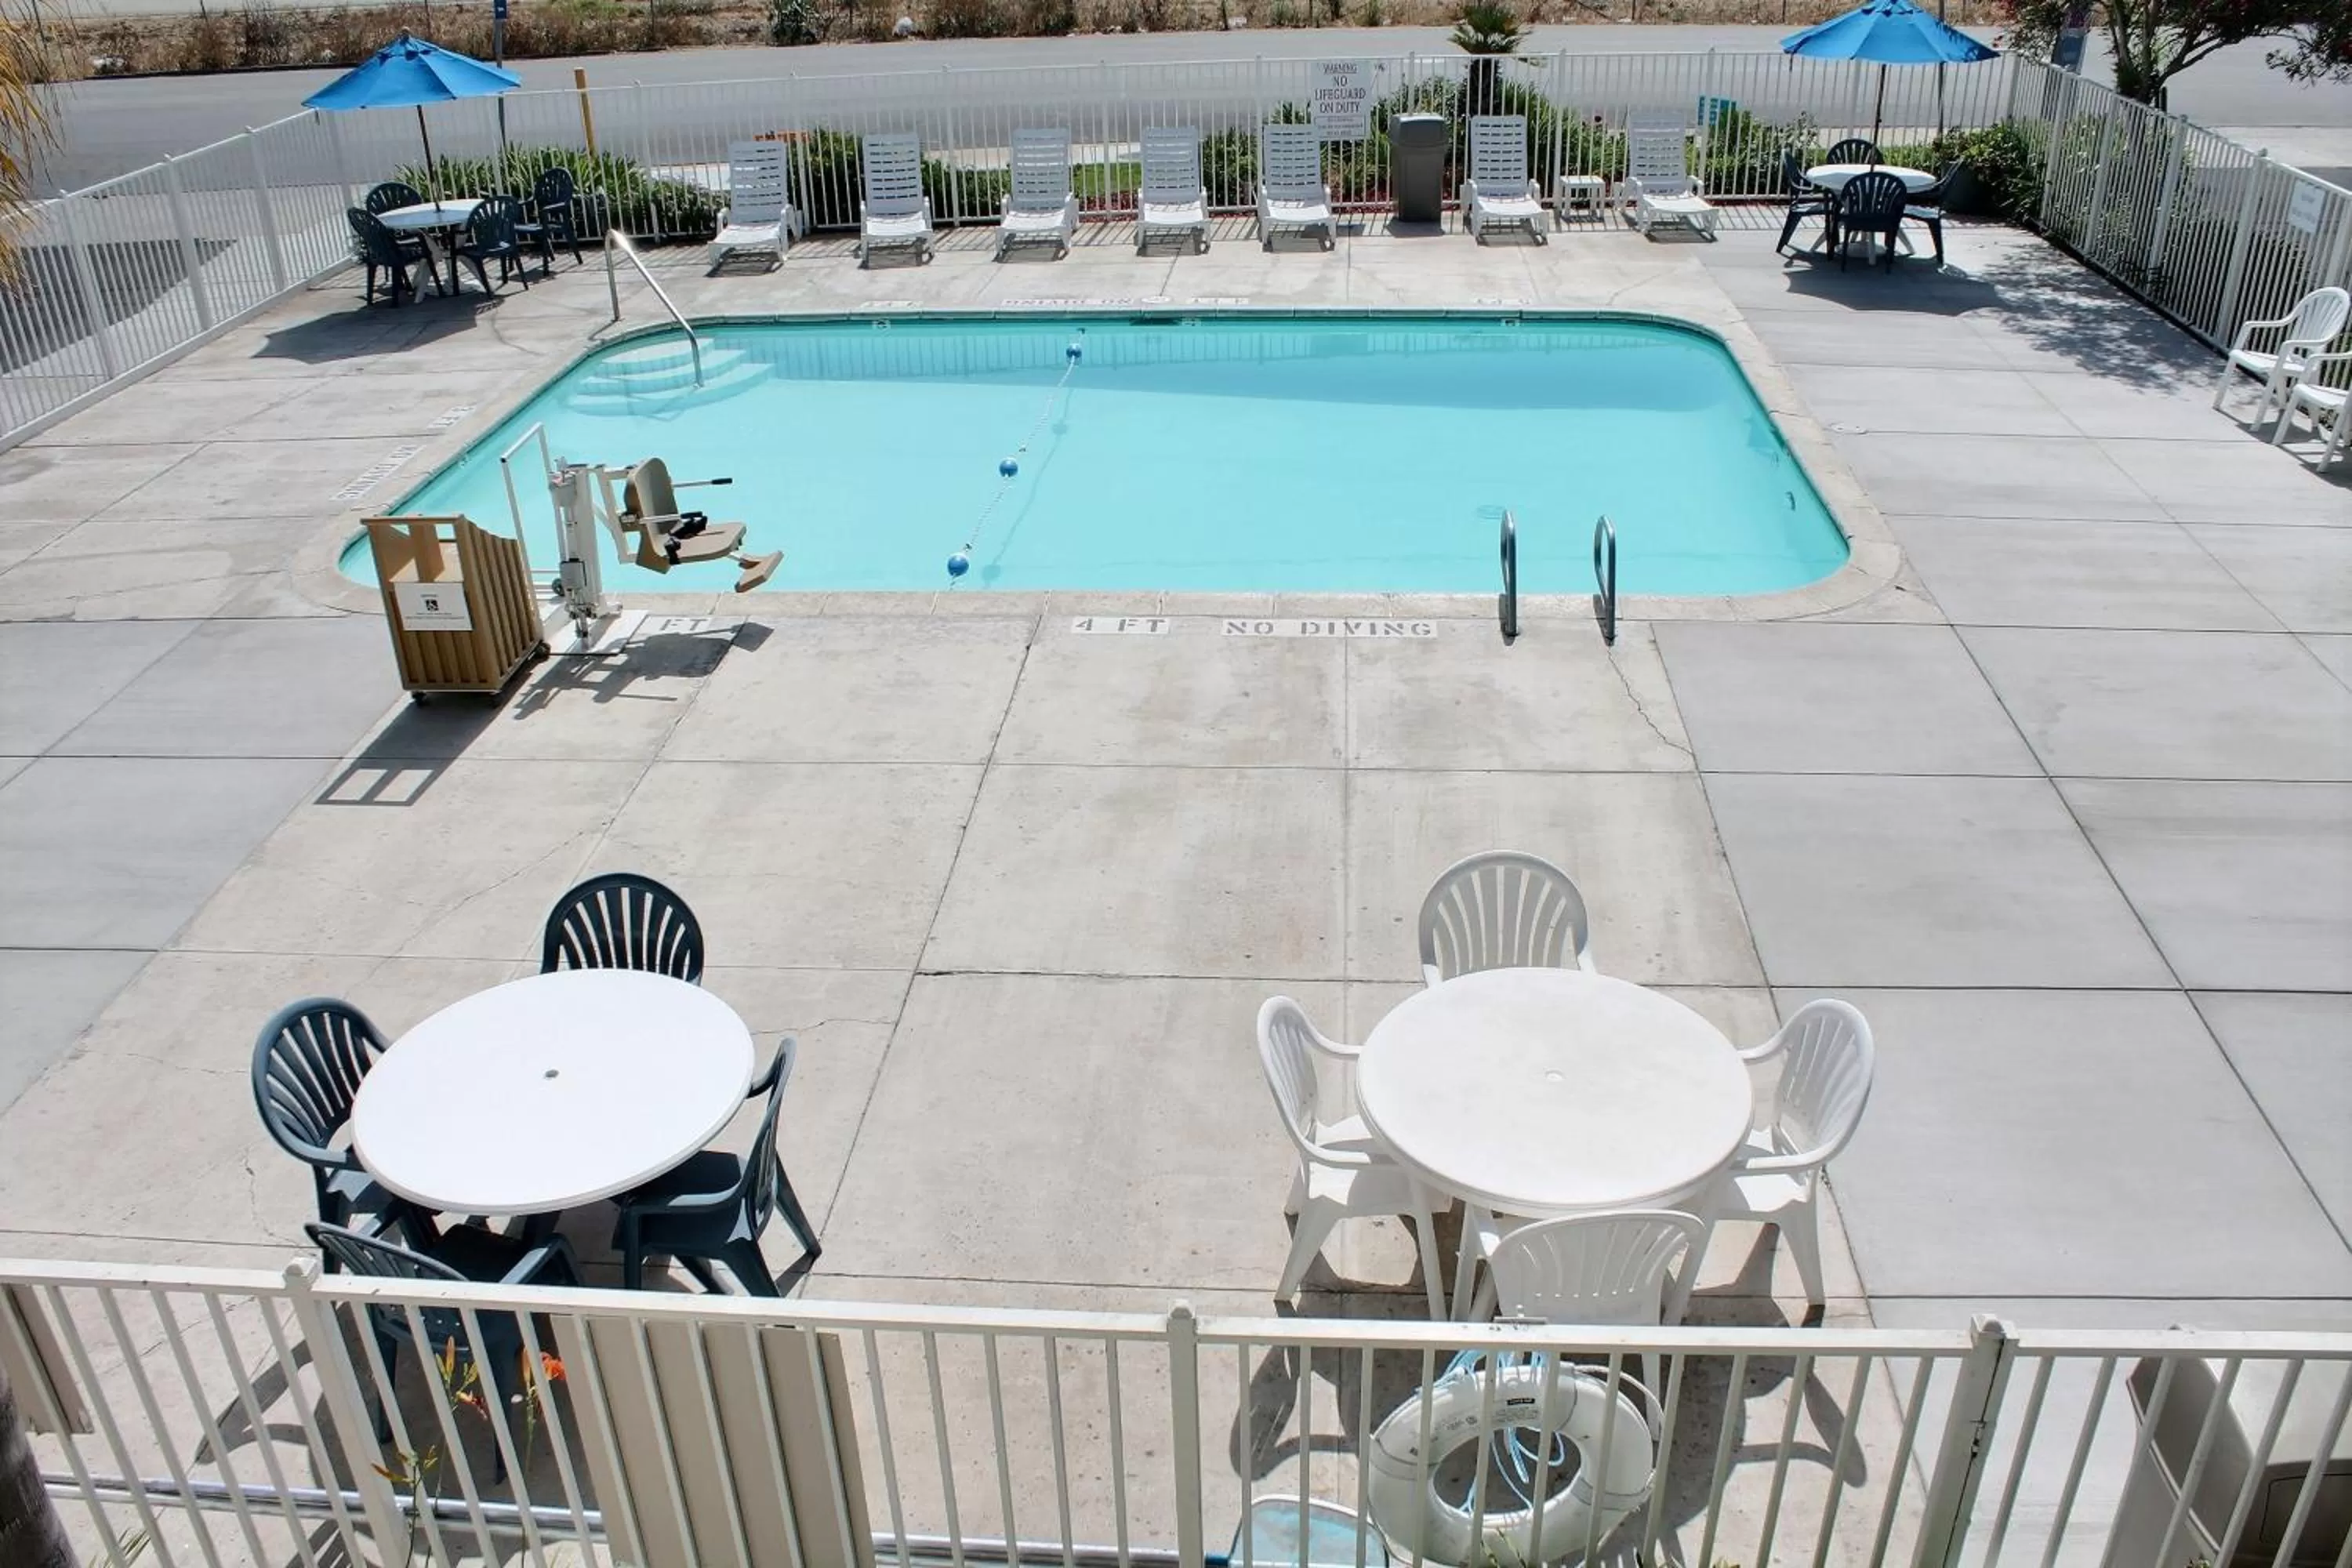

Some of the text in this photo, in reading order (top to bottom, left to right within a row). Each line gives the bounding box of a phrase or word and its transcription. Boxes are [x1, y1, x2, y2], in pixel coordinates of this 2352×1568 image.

[1333, 75, 1348, 87] NO
[1314, 87, 1367, 101] LIFEGUARD
[1319, 100, 1360, 114] ON DUTY
[659, 618, 710, 631] FT
[1075, 617, 1166, 633] 4 FT
[1226, 621, 1431, 636] NO DIVING
